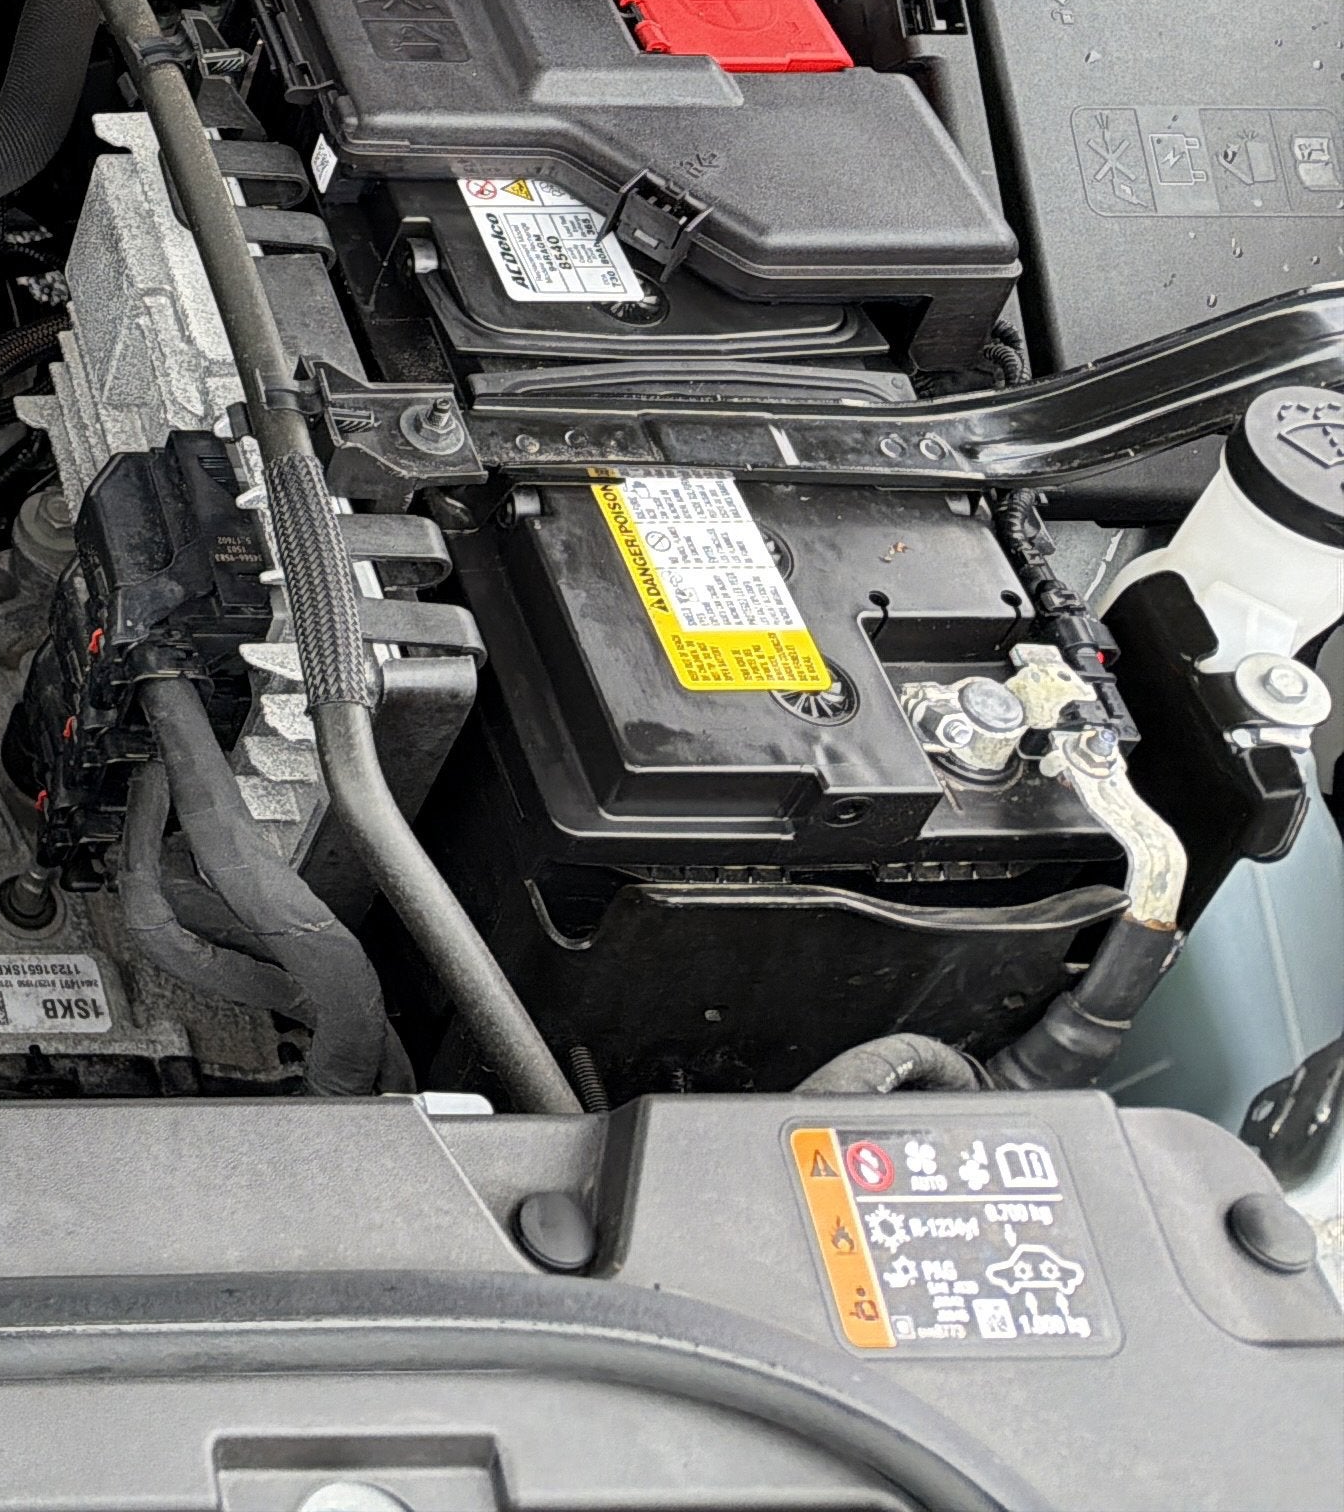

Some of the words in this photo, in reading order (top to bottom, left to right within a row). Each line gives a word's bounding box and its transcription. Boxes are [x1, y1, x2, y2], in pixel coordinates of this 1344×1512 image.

[580, 218, 595, 234] 365
[484, 212, 530, 289] ACDelco
[544, 235, 573, 269] 8540
[606, 270, 621, 287] 730
[41, 998, 105, 1020] 1SKB
